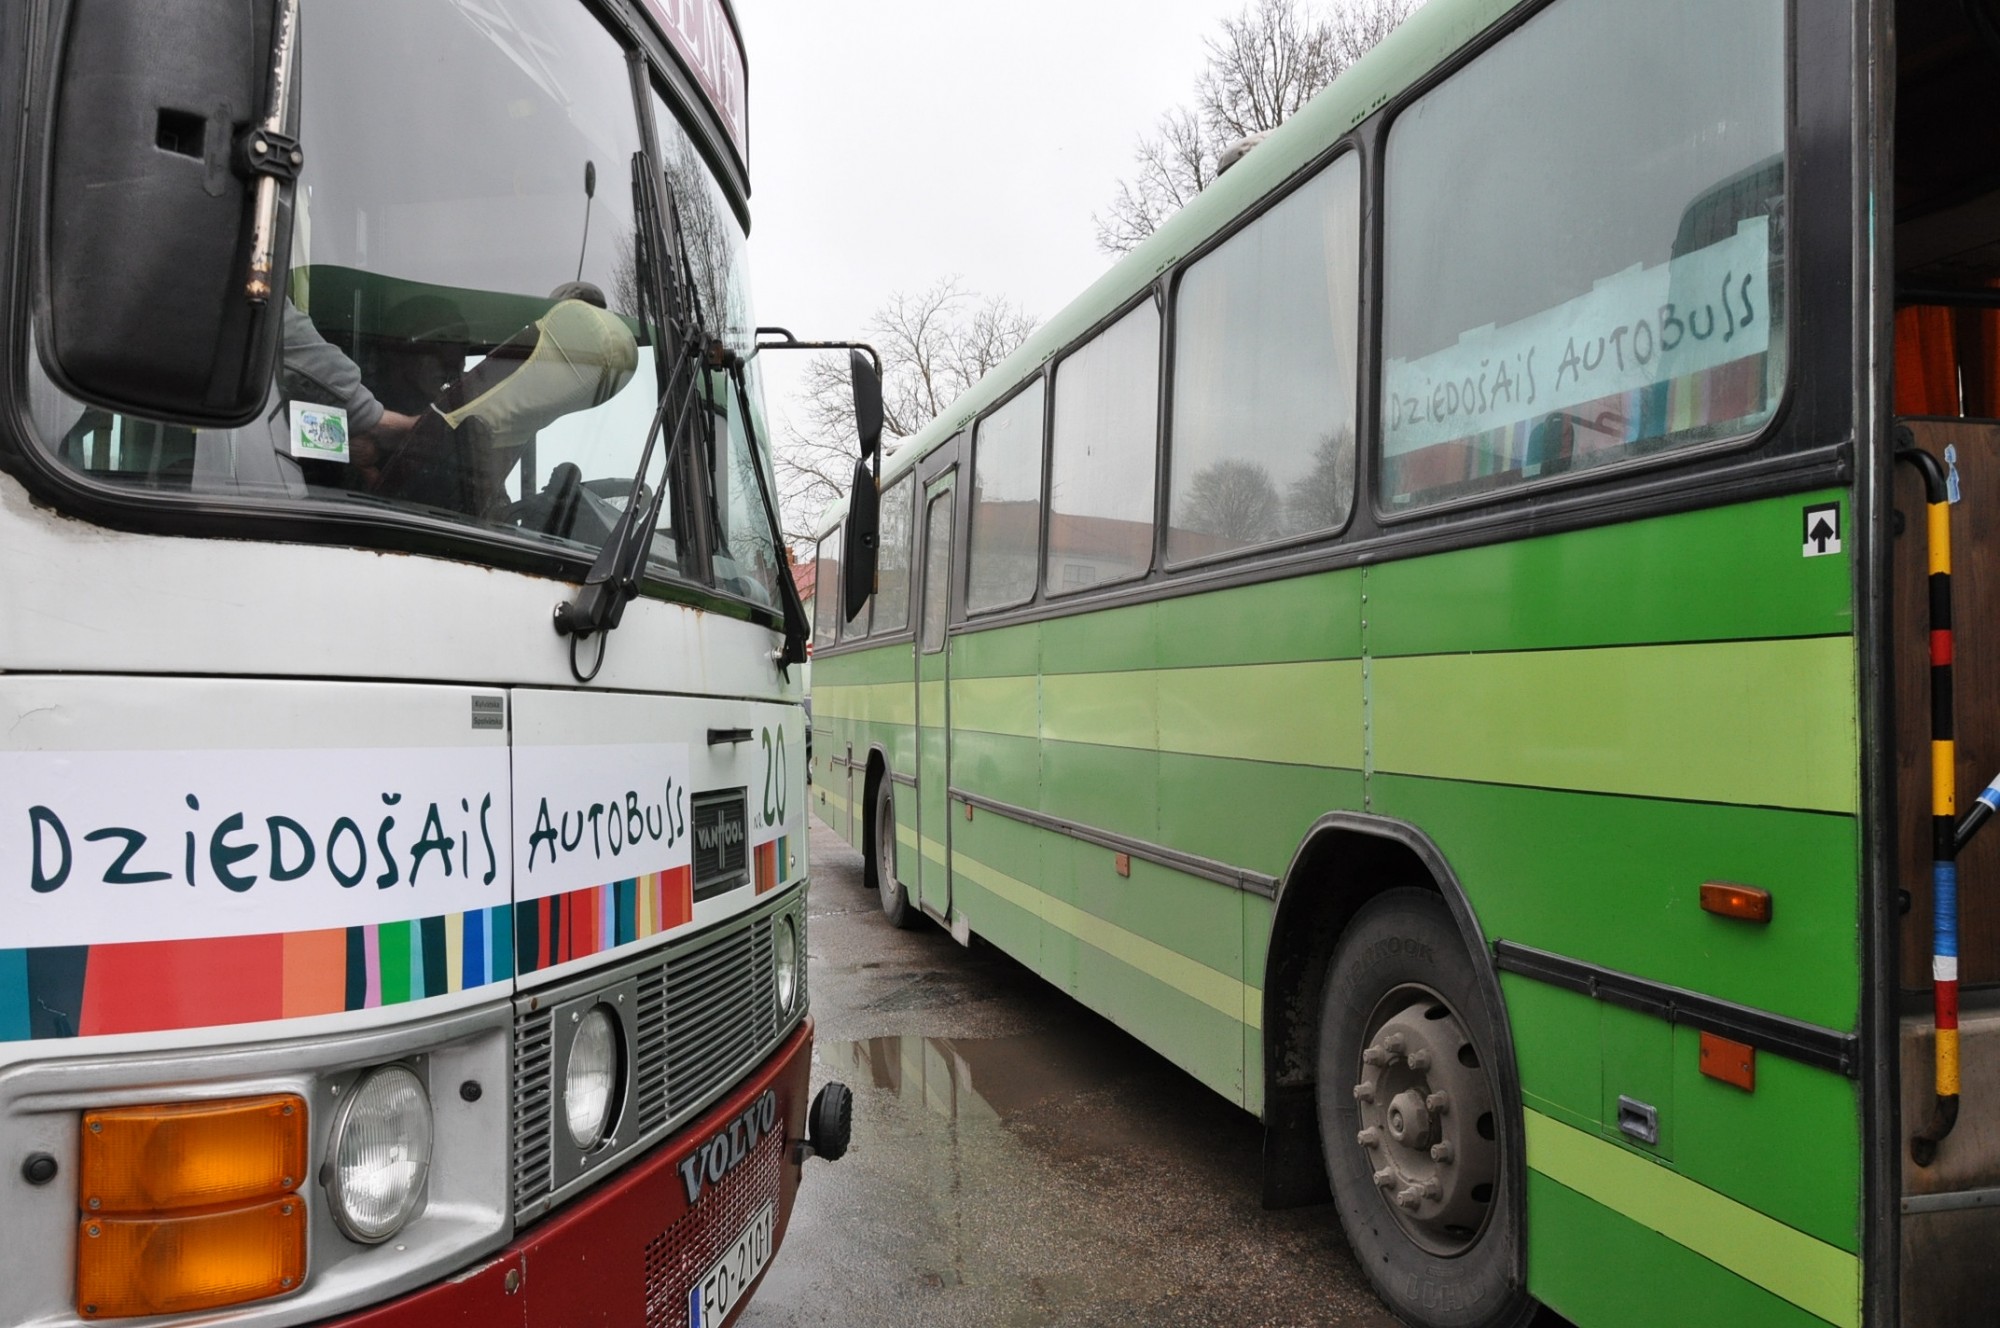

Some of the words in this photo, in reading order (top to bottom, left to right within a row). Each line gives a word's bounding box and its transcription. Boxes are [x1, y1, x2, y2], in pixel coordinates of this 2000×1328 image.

[1556, 270, 1754, 392] AUTOBUSS
[528, 776, 685, 873] AUTOBUSS
[762, 723, 787, 827] 20
[680, 1089, 777, 1204] VOLVO
[703, 1211, 770, 1328] FO-2101
